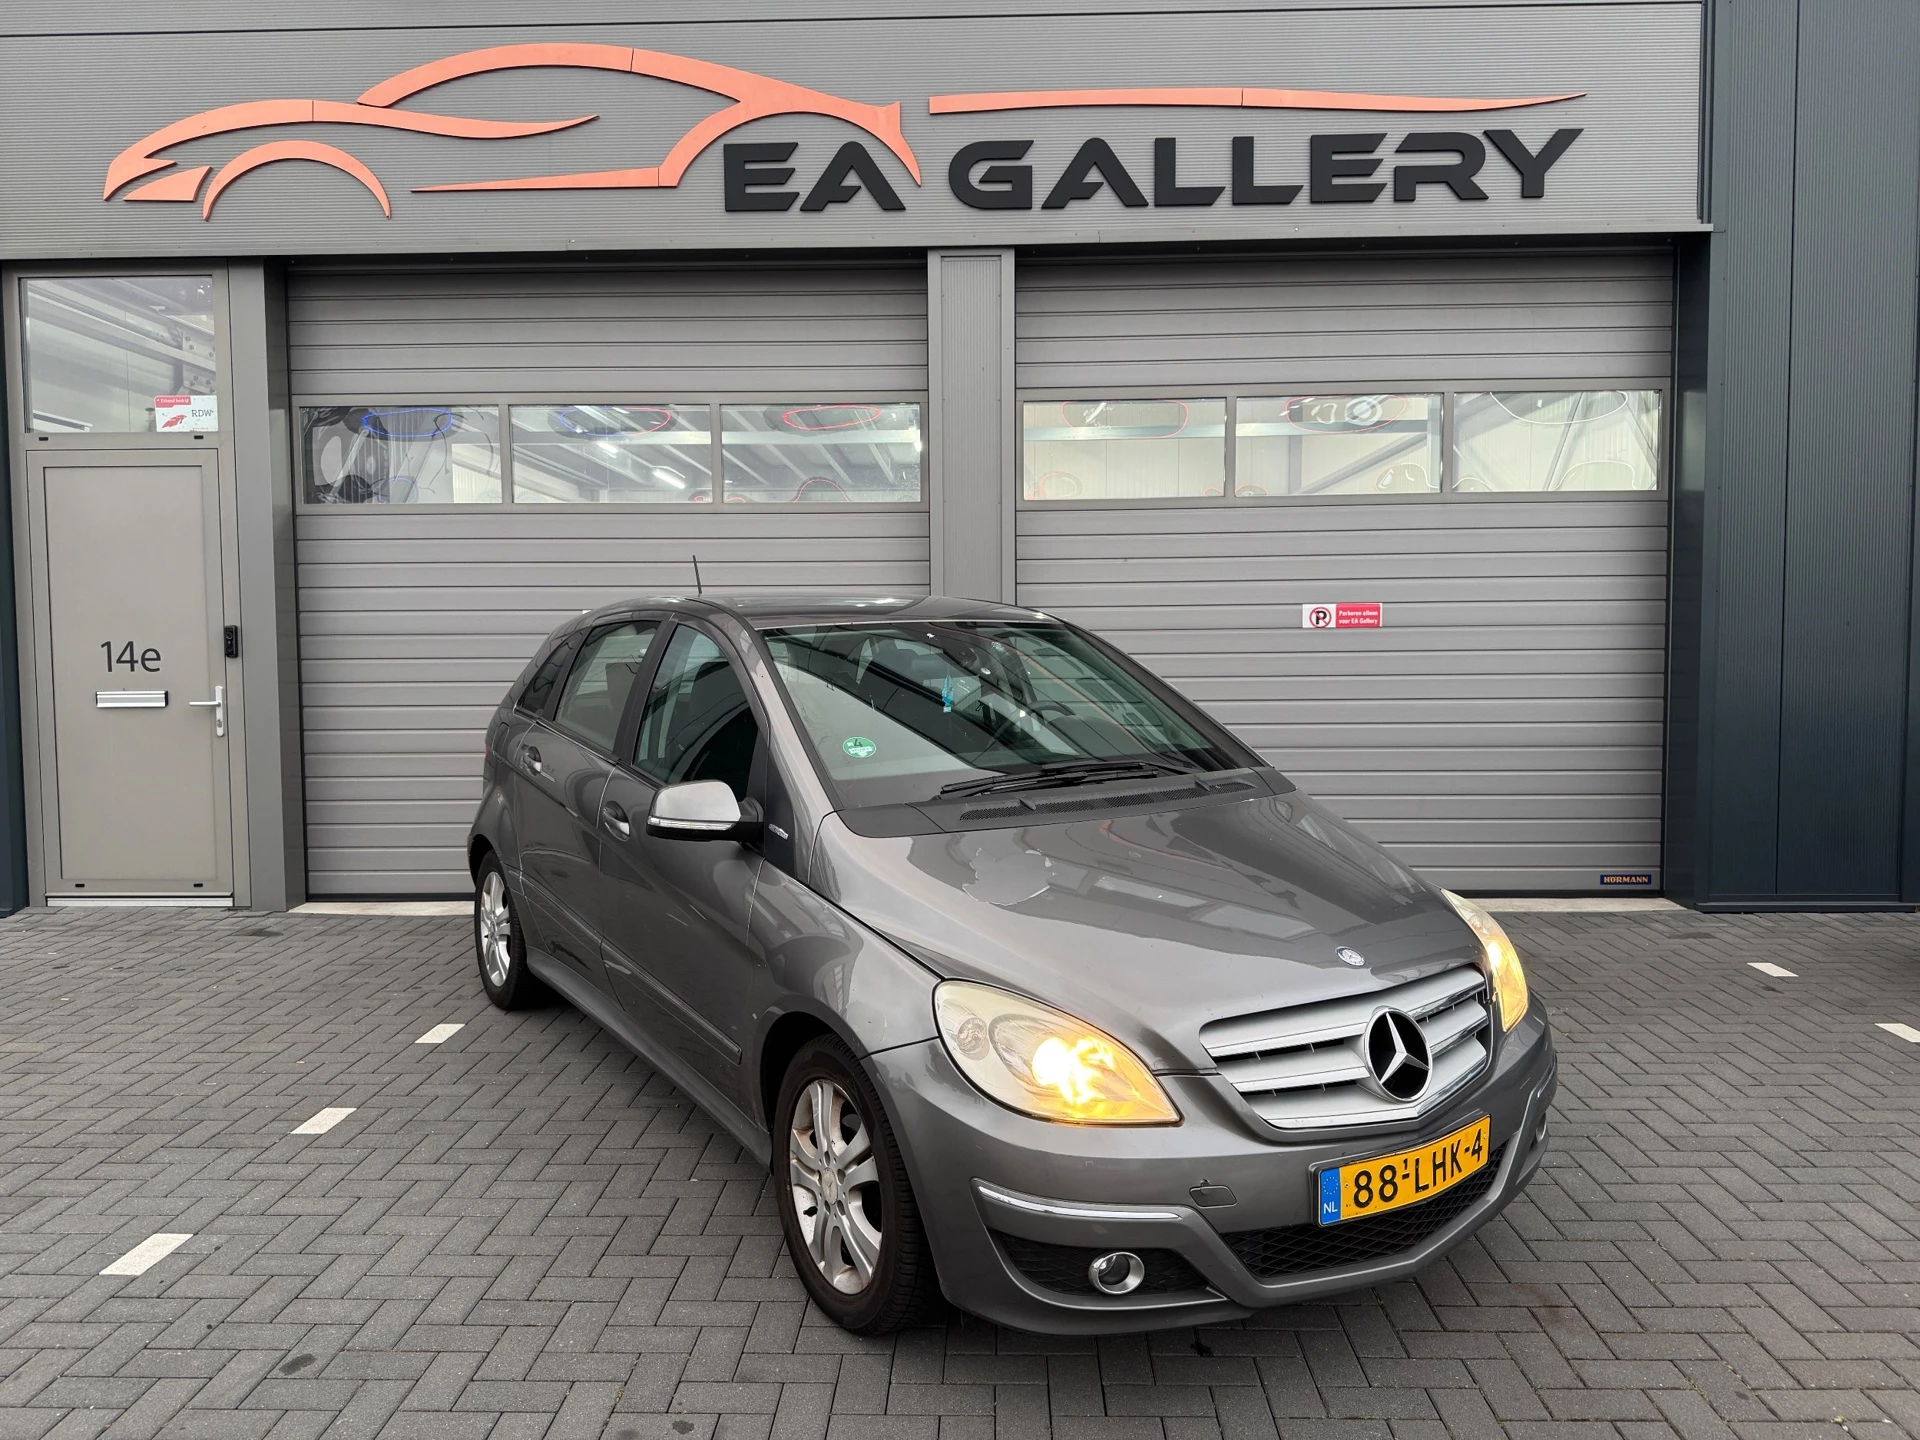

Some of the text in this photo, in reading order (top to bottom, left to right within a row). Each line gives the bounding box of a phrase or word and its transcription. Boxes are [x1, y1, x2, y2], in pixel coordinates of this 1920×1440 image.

[724, 128, 1585, 212] EA GALLERY
[191, 409, 212, 417] RDW
[100, 641, 161, 672] 14e
[854, 738, 863, 747] 4
[1353, 1128, 1483, 1209] 88-LHK-4
[1323, 1201, 1338, 1214] NL
